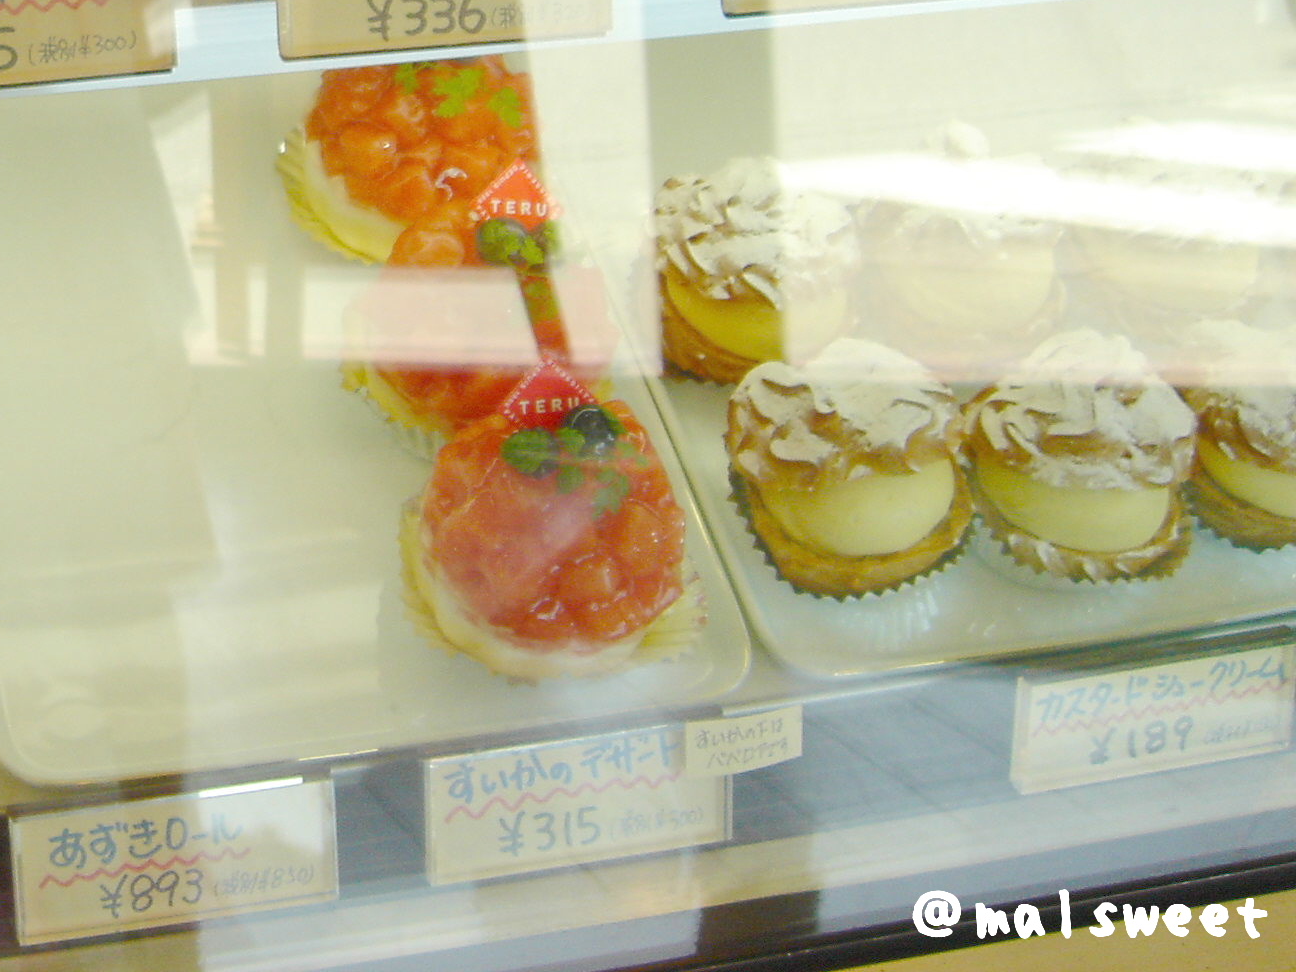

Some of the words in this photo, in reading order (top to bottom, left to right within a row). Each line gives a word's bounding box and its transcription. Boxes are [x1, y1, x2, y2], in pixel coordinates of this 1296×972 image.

[490, 198, 547, 217] TERU
[1089, 715, 1194, 765] ¥189
[444, 730, 681, 804] すいかのデザート
[49, 812, 244, 869] あずきロール
[499, 806, 601, 857] ¥315
[100, 868, 203, 918] ¥893
